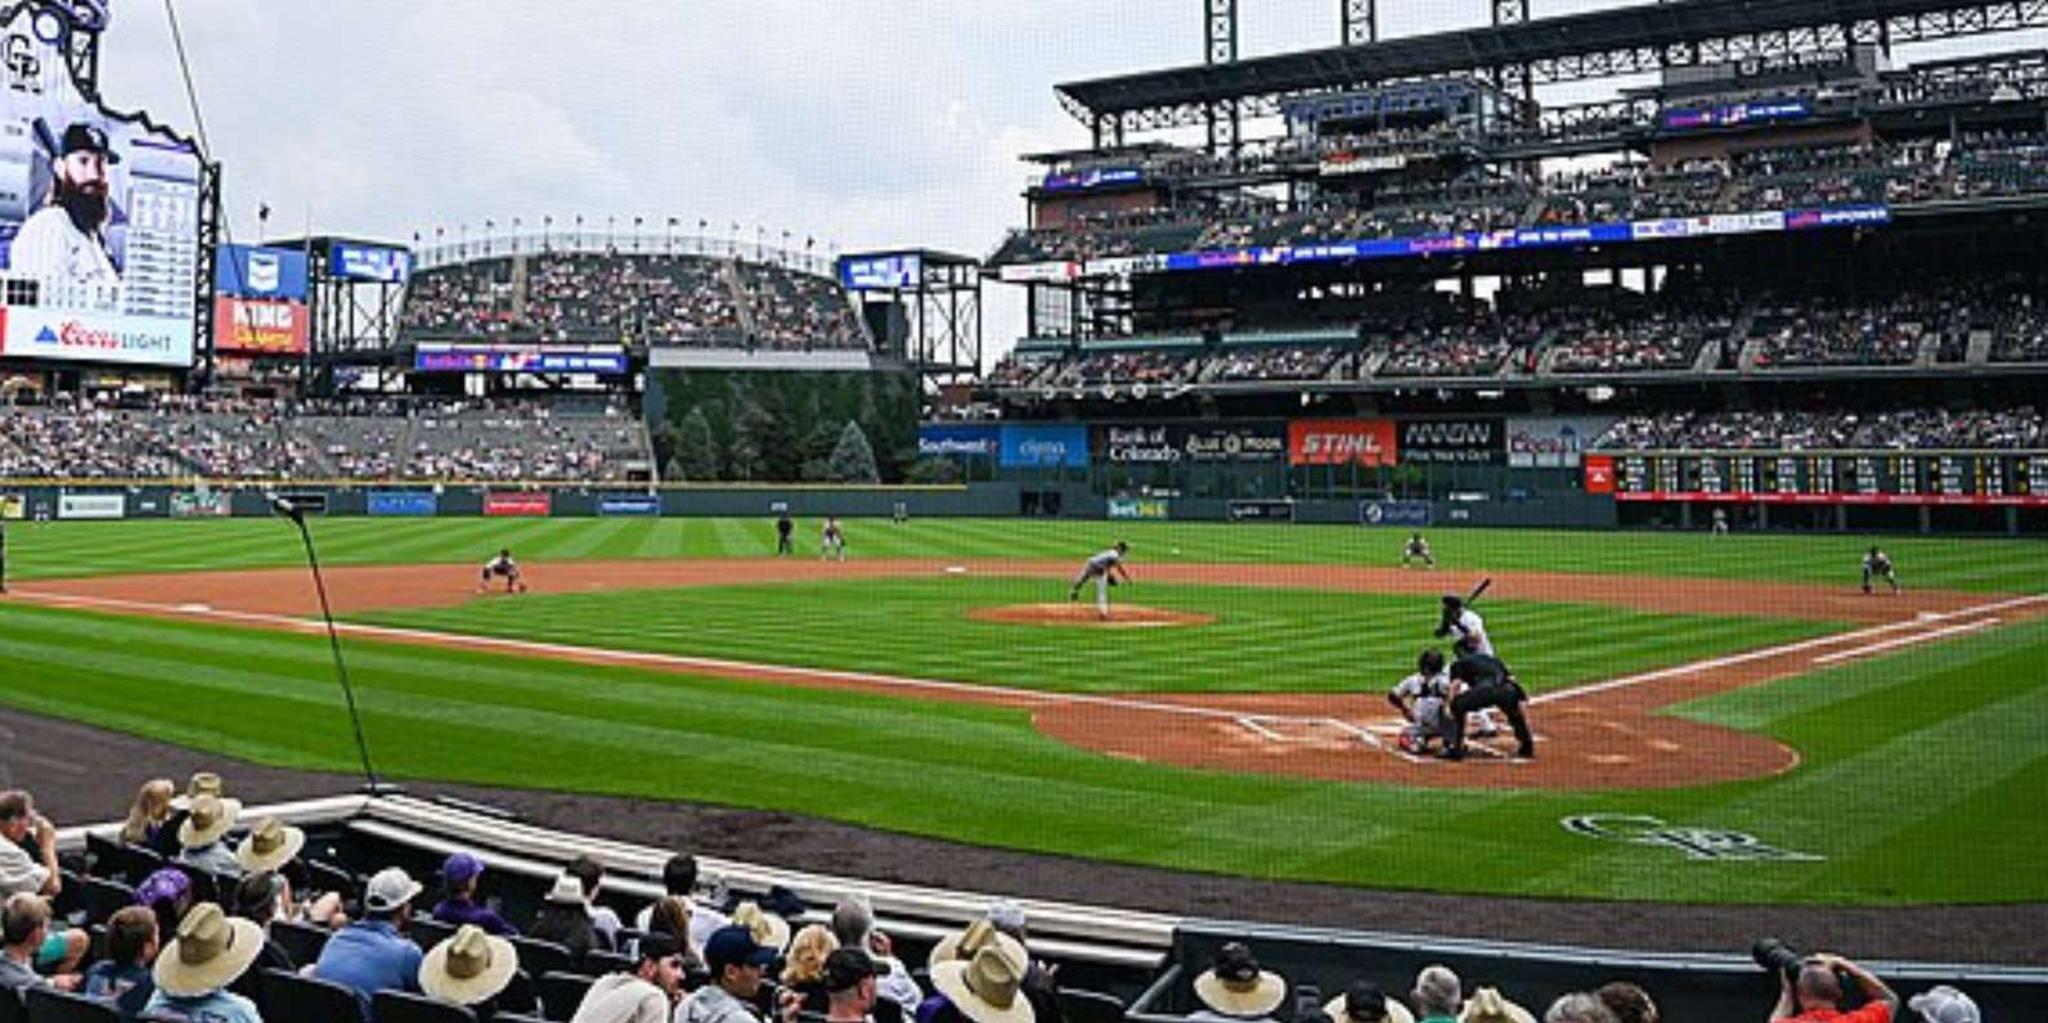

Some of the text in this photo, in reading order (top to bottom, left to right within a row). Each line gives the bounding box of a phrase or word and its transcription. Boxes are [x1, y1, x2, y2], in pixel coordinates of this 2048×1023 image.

[233, 301, 293, 329] KING
[60, 322, 171, 352] Coors LIGHT
[1110, 426, 1167, 444] Bank of
[1405, 422, 1490, 444] ARROW
[918, 437, 986, 454] Southwest
[1302, 433, 1382, 454] STIHL
[1110, 444, 1181, 464] Colorado
[1108, 499, 1168, 518] bet365
